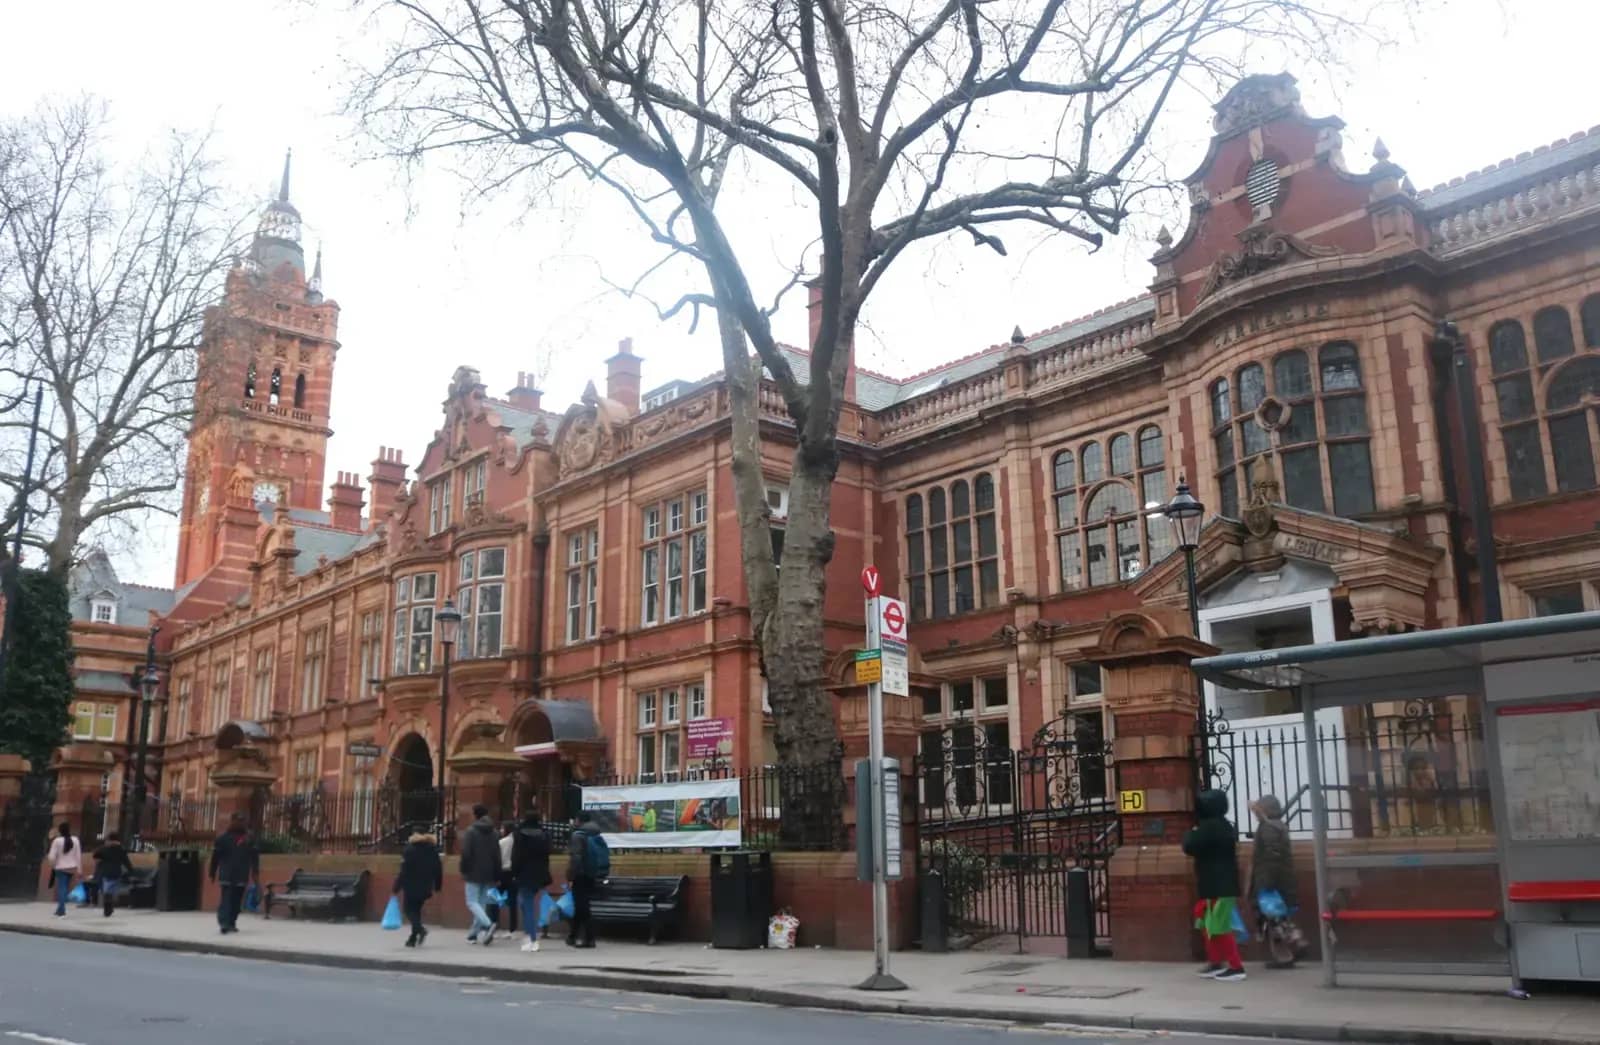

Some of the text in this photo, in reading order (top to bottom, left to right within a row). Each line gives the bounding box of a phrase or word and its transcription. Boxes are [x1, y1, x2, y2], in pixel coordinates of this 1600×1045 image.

[1213, 303, 1329, 348] CARNEGIE
[1284, 536, 1345, 563] LIBRARY
[866, 570, 878, 590] V
[1122, 792, 1142, 810] HD
